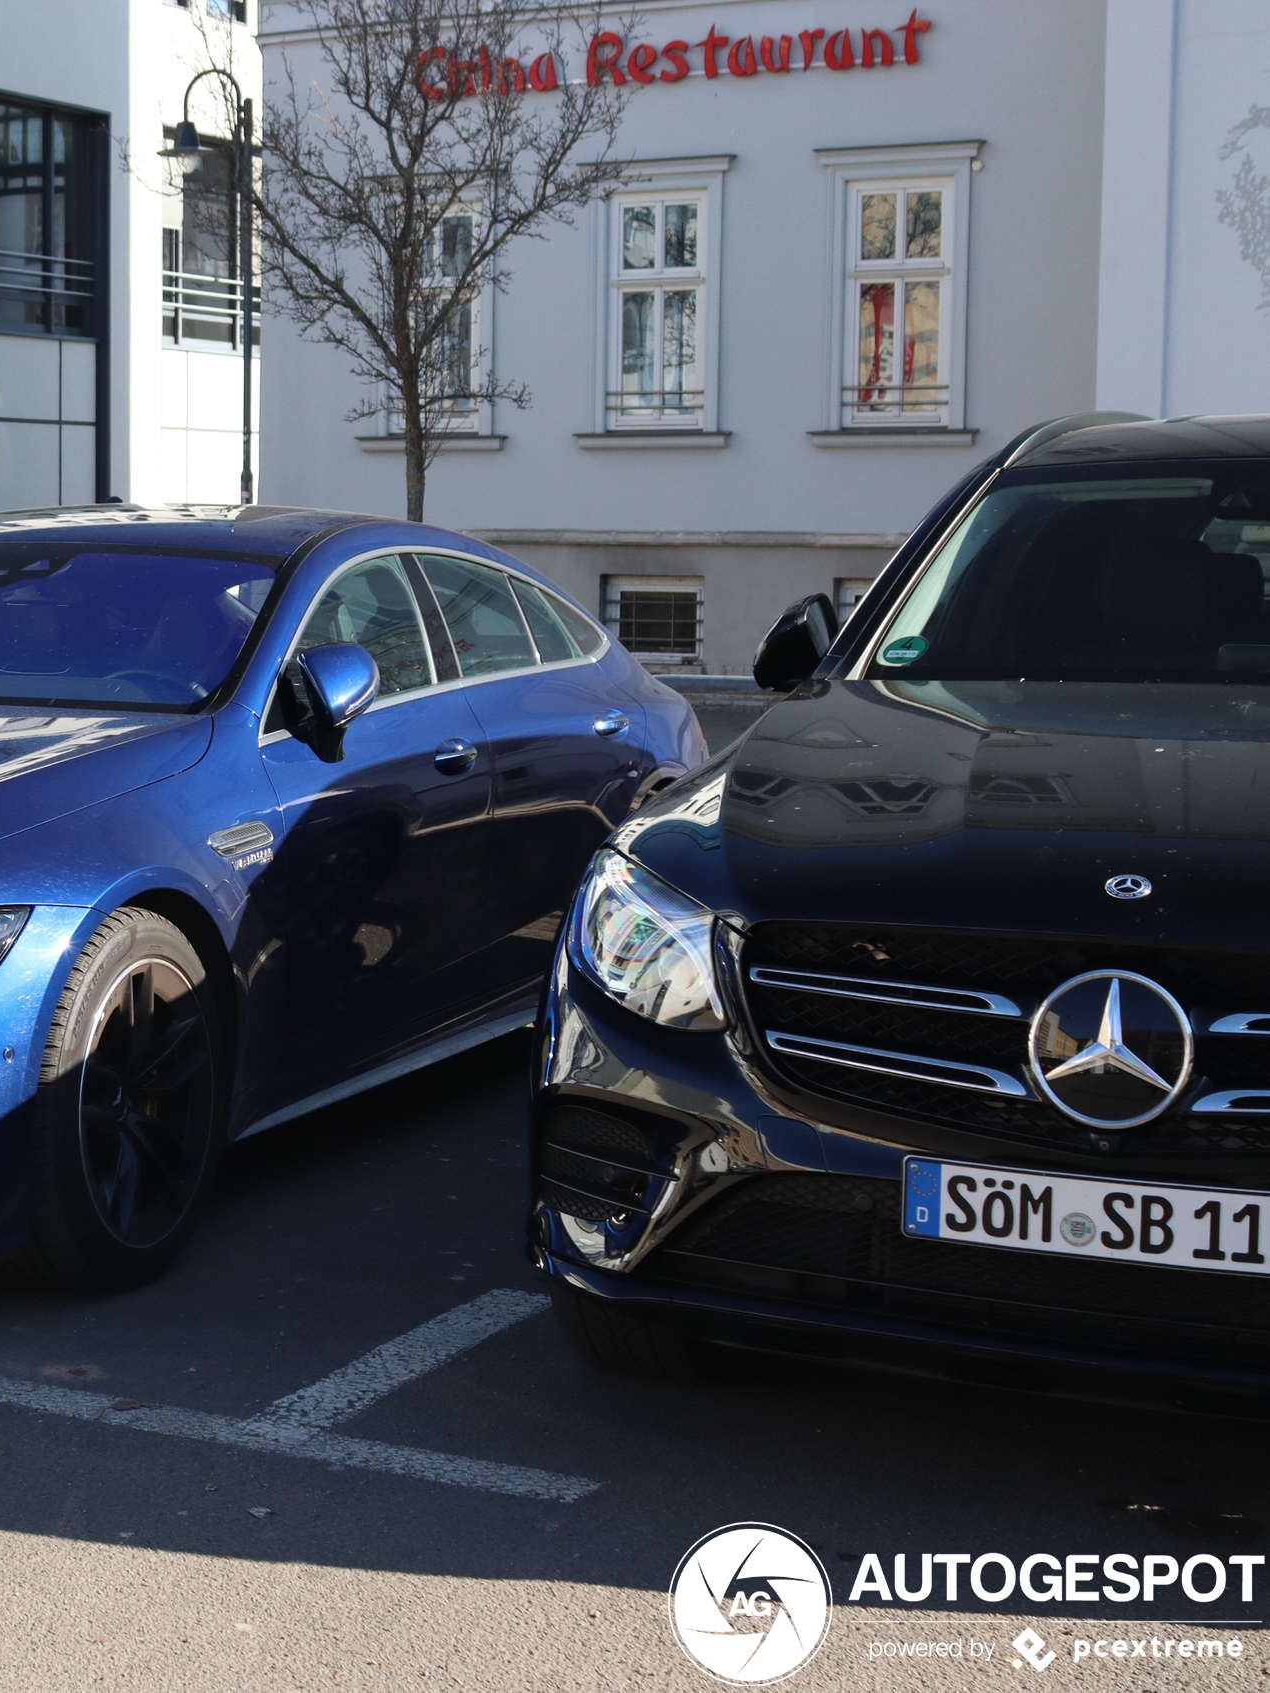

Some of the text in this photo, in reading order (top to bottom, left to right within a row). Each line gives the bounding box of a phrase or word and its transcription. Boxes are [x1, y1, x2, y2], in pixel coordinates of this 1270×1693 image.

[418, 7, 932, 100] China Restaurant
[901, 637, 914, 651] 4
[916, 1206, 928, 1223] D
[945, 1175, 1053, 1243] SÖM
[1101, 1192, 1174, 1254] SB
[1192, 1200, 1265, 1264] 11
